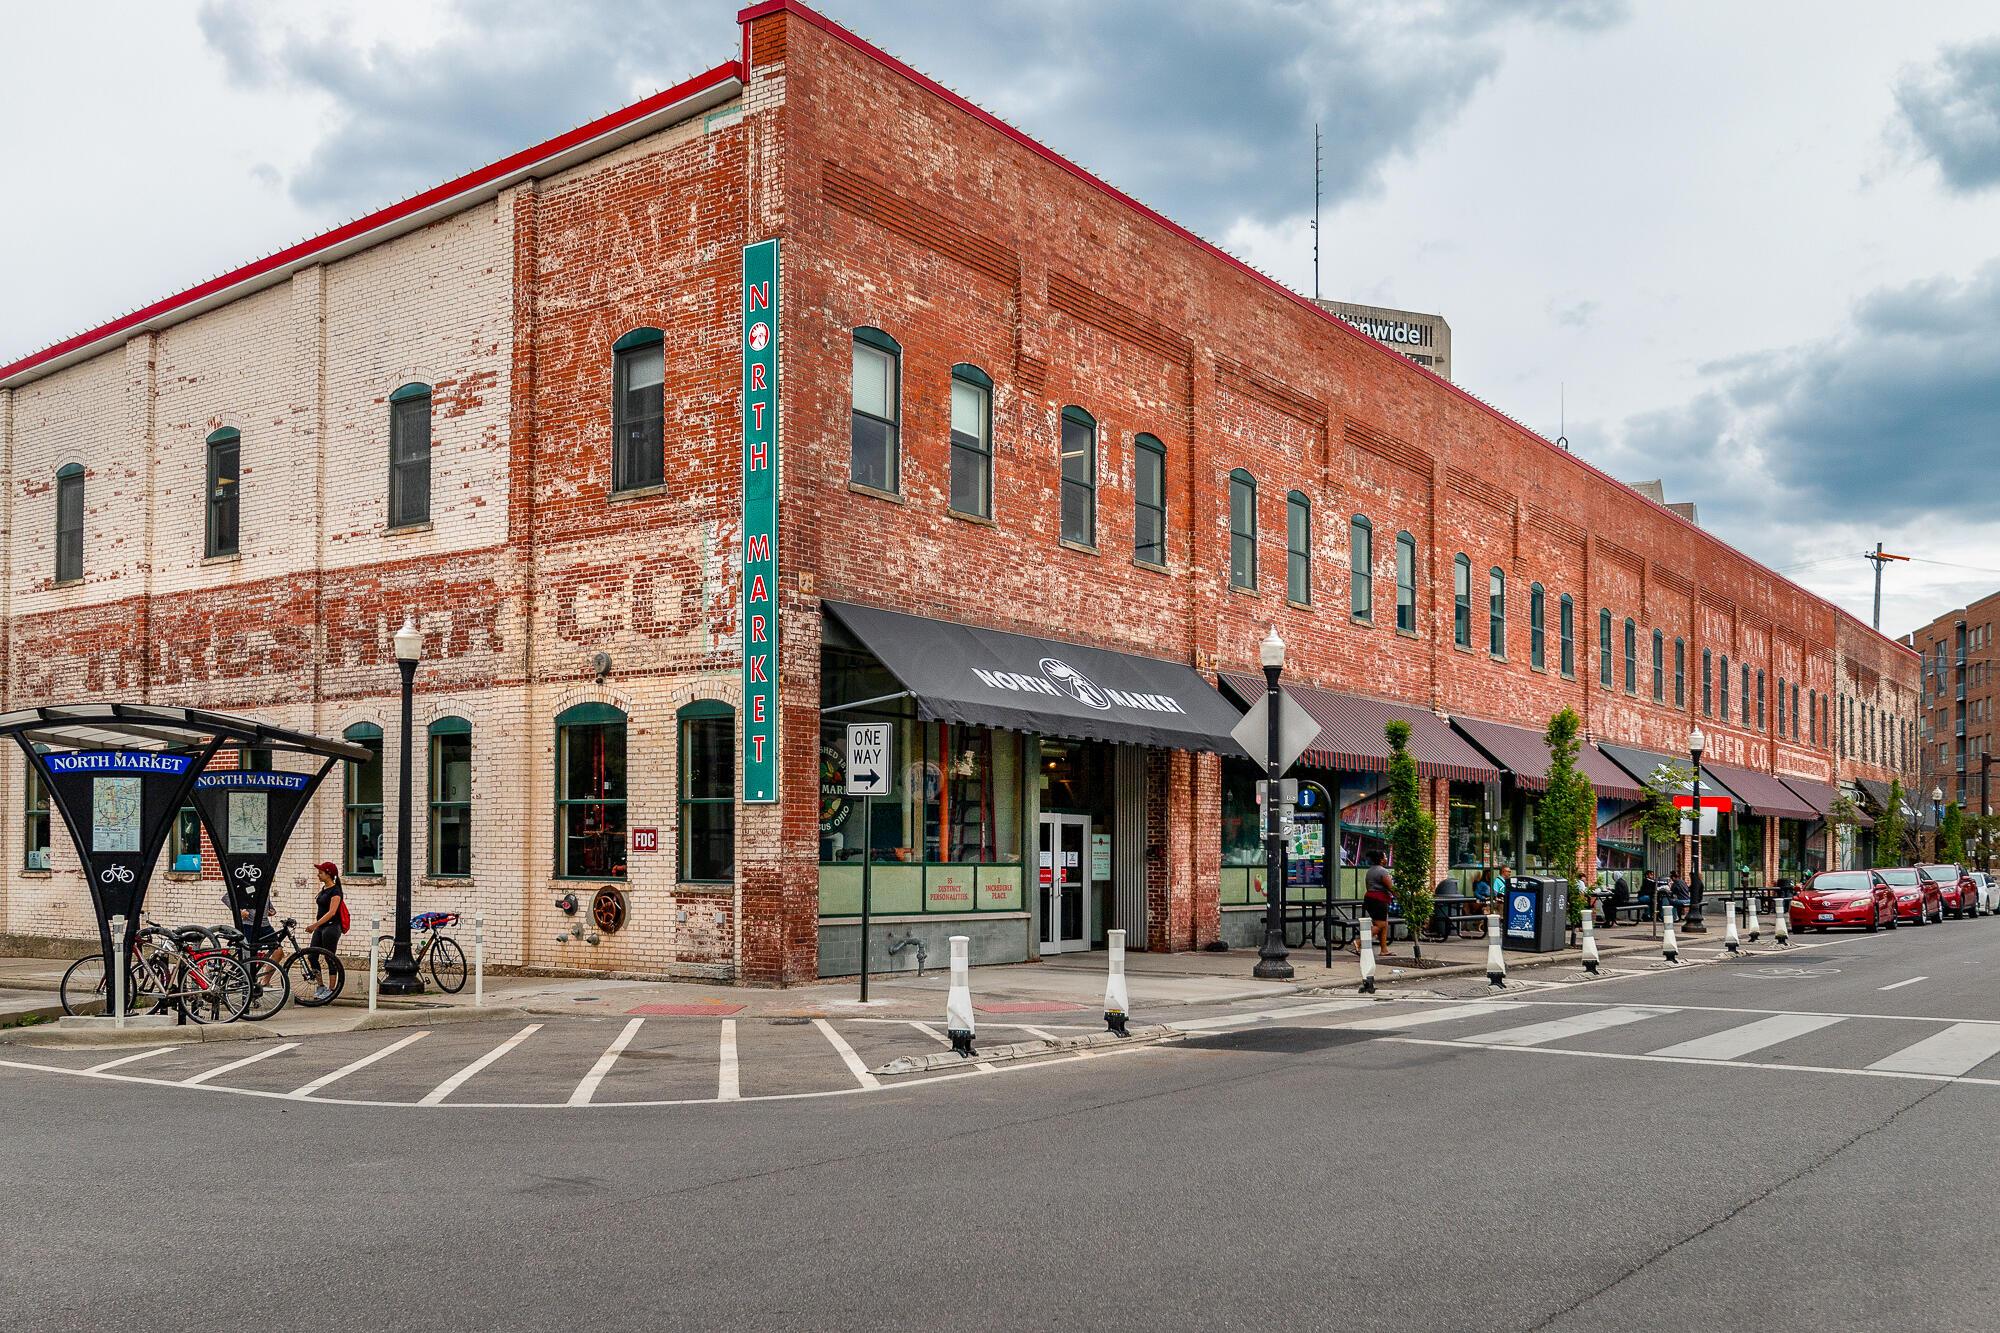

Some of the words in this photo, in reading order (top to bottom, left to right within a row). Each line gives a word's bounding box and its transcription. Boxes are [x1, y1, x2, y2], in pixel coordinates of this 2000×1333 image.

[747, 533, 770, 763] MARKET
[971, 667, 1062, 697] NORTH
[1103, 687, 1187, 714] MARKET
[855, 729, 881, 746] ONE
[54, 757, 109, 770] NORTH
[114, 755, 182, 771] MARKET
[854, 749, 881, 764] WAY
[198, 775, 242, 786] NORTH
[246, 775, 302, 788] MARKET
[834, 805, 850, 827] OHIO
[635, 832, 655, 848] FDC
